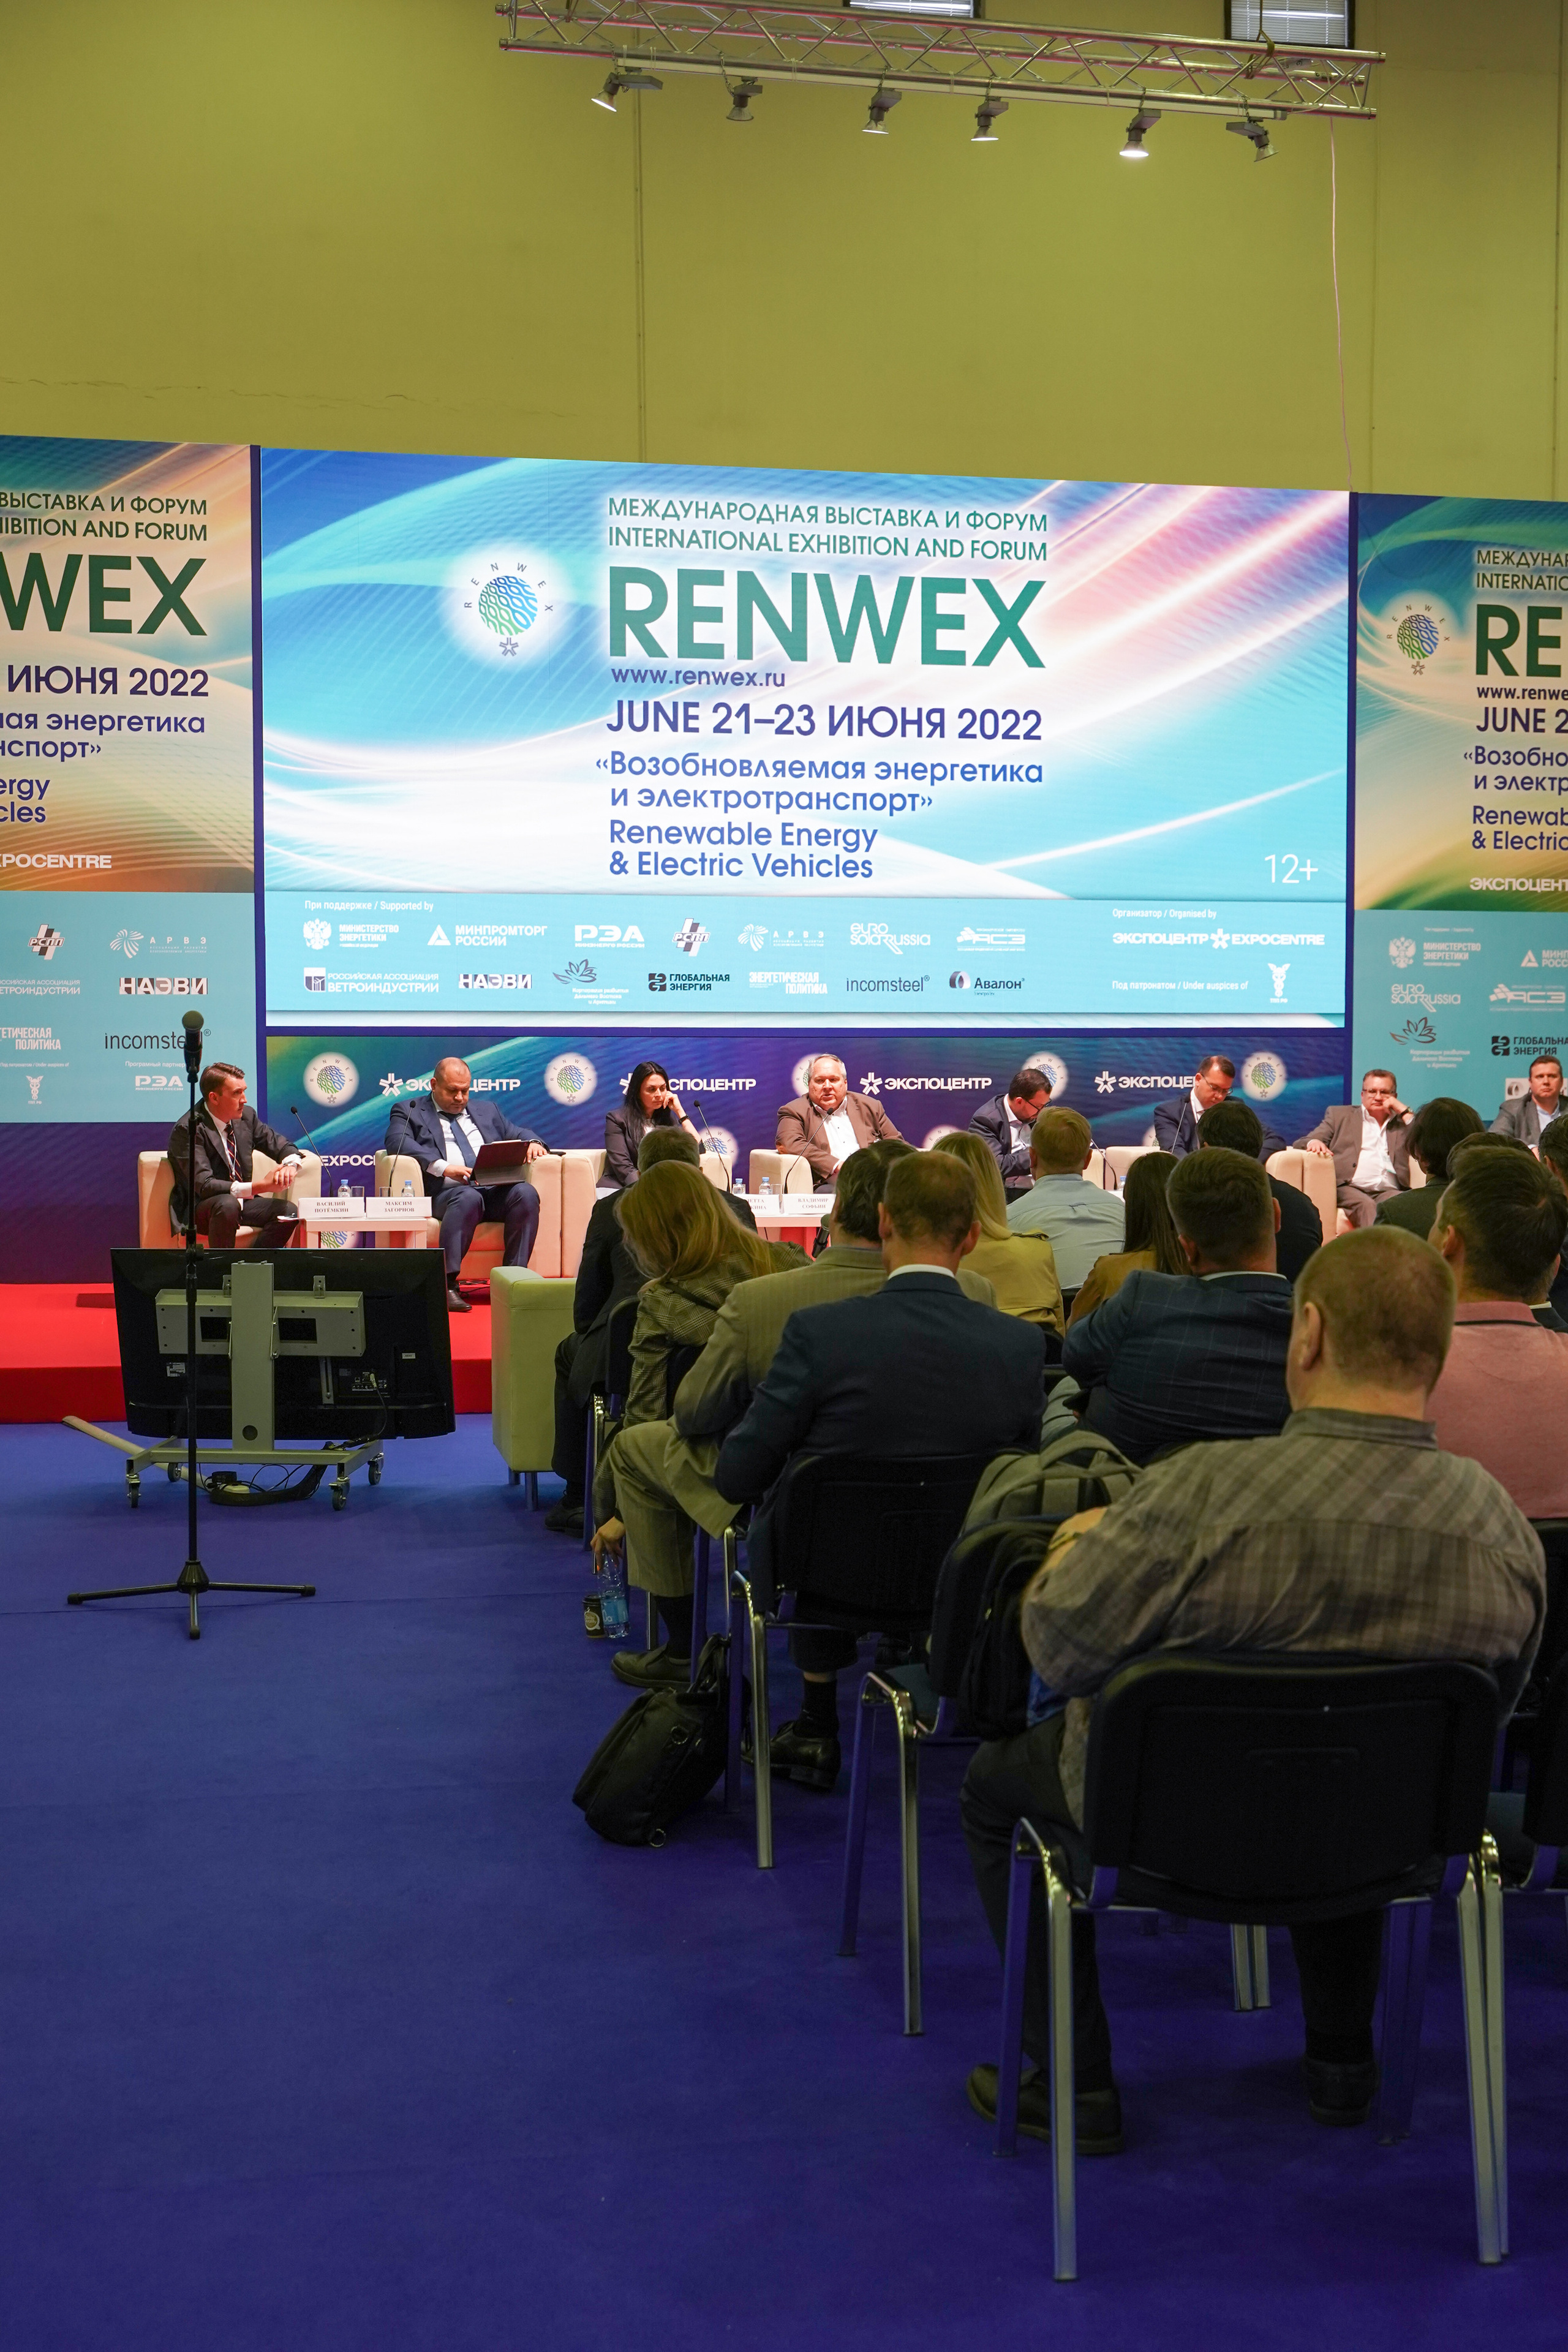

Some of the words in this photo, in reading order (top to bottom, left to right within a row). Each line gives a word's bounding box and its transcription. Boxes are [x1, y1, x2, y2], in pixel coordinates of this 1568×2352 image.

[0, 492, 105, 511] ВЫСТАВКА
[111, 496, 124, 512] И
[130, 496, 208, 515] ФОРУМ
[609, 497, 818, 524] МЕЖДУНАРОДНАЯ
[825, 506, 939, 528] ВЫСТАВКА
[946, 510, 959, 529] И
[966, 510, 1047, 532] ФОРУМ
[0, 517, 77, 537] IBITION
[83, 520, 129, 538] AND
[135, 522, 208, 541] FORUM
[609, 526, 783, 552] INTERNATIONAL
[788, 533, 908, 557] EXHIBITION
[915, 538, 964, 558] AND
[971, 540, 1047, 561] FORUM
[464, 562, 553, 611] RENWEX
[1477, 572, 1568, 591] INTERNATIO
[0, 552, 208, 636] WEX
[609, 566, 1047, 669] RENWEX
[1387, 604, 1450, 641] RENWEX
[1476, 604, 1562, 678] RE
[7, 665, 118, 695] ИЮНЯ
[129, 668, 209, 696] 2022
[611, 668, 785, 687] www.renwex.ru
[1477, 687, 1568, 701] www.renwe
[0, 712, 38, 729] ая
[47, 714, 205, 736] энергетика
[606, 699, 699, 733] JUNE
[829, 705, 945, 738] ИЮНЯ
[957, 707, 1042, 741] 2022
[1476, 707, 1546, 733] JUNE
[874, 761, 1042, 786] энергетика
[1474, 774, 1487, 790] и
[1493, 775, 1568, 796] электр
[610, 788, 628, 806] и
[610, 820, 772, 846] Renewable
[781, 822, 878, 853] Energy
[1472, 830, 1487, 850] &
[1493, 831, 1568, 851] Electric
[0, 853, 112, 869] POCENTRE
[609, 850, 629, 876] &
[638, 851, 744, 876] Electric
[752, 853, 873, 878] Vehicles
[1264, 854, 1318, 883] 12+
[304, 900, 322, 910] При
[323, 902, 372, 911] поддержке
[380, 901, 422, 912] Supported
[424, 901, 434, 912] by
[1112, 909, 1162, 919] Организатор
[1169, 909, 1206, 919] Organised
[1208, 910, 1217, 920] by
[339, 924, 399, 933] МИНИСТЕРСТВО
[455, 925, 548, 936] МИНПРОМТОРГ
[575, 925, 645, 942] РЭА
[29, 938, 64, 946] РСПП
[455, 936, 507, 946] РОССИИ
[674, 933, 709, 941] РСПП
[1112, 932, 1209, 945] ЭКСПОЦЕНТР
[1232, 933, 1325, 945] EXPOCENTRE
[1423, 942, 1481, 951] МИНИСТЕРСТВО
[1423, 951, 1469, 960] ЭНЕРГЕТИКИ
[459, 974, 532, 989] НАЭВИ
[749, 971, 819, 983] ЭНЕРГЕТИЧЕСКАЯ
[119, 978, 208, 995] НАЭВИ
[328, 982, 439, 993] ВЕТРОИНДУСТРИИ
[785, 983, 827, 994] ПОЛИТИКА
[1112, 981, 1128, 990] Под
[1129, 982, 1176, 991] патронатом
[1206, 981, 1238, 991] auspices
[1240, 981, 1248, 990] of
[0, 1027, 52, 1039] ЕТИЧЕСКАЯ
[15, 1039, 62, 1050] ПОЛИТИКА
[1513, 1046, 1557, 1055] ЭНЕРГИЯ
[135, 1076, 183, 1087] РЭА
[405, 1078, 521, 1092] ЭКЦЕНТР
[668, 1078, 757, 1092] СПОЦЕНТР
[884, 1077, 992, 1091] ЭКСПОЦЕНТР
[1118, 1076, 1195, 1089] ЭКСПОЦЕ
[320, 1155, 375, 1166] EXPOC
